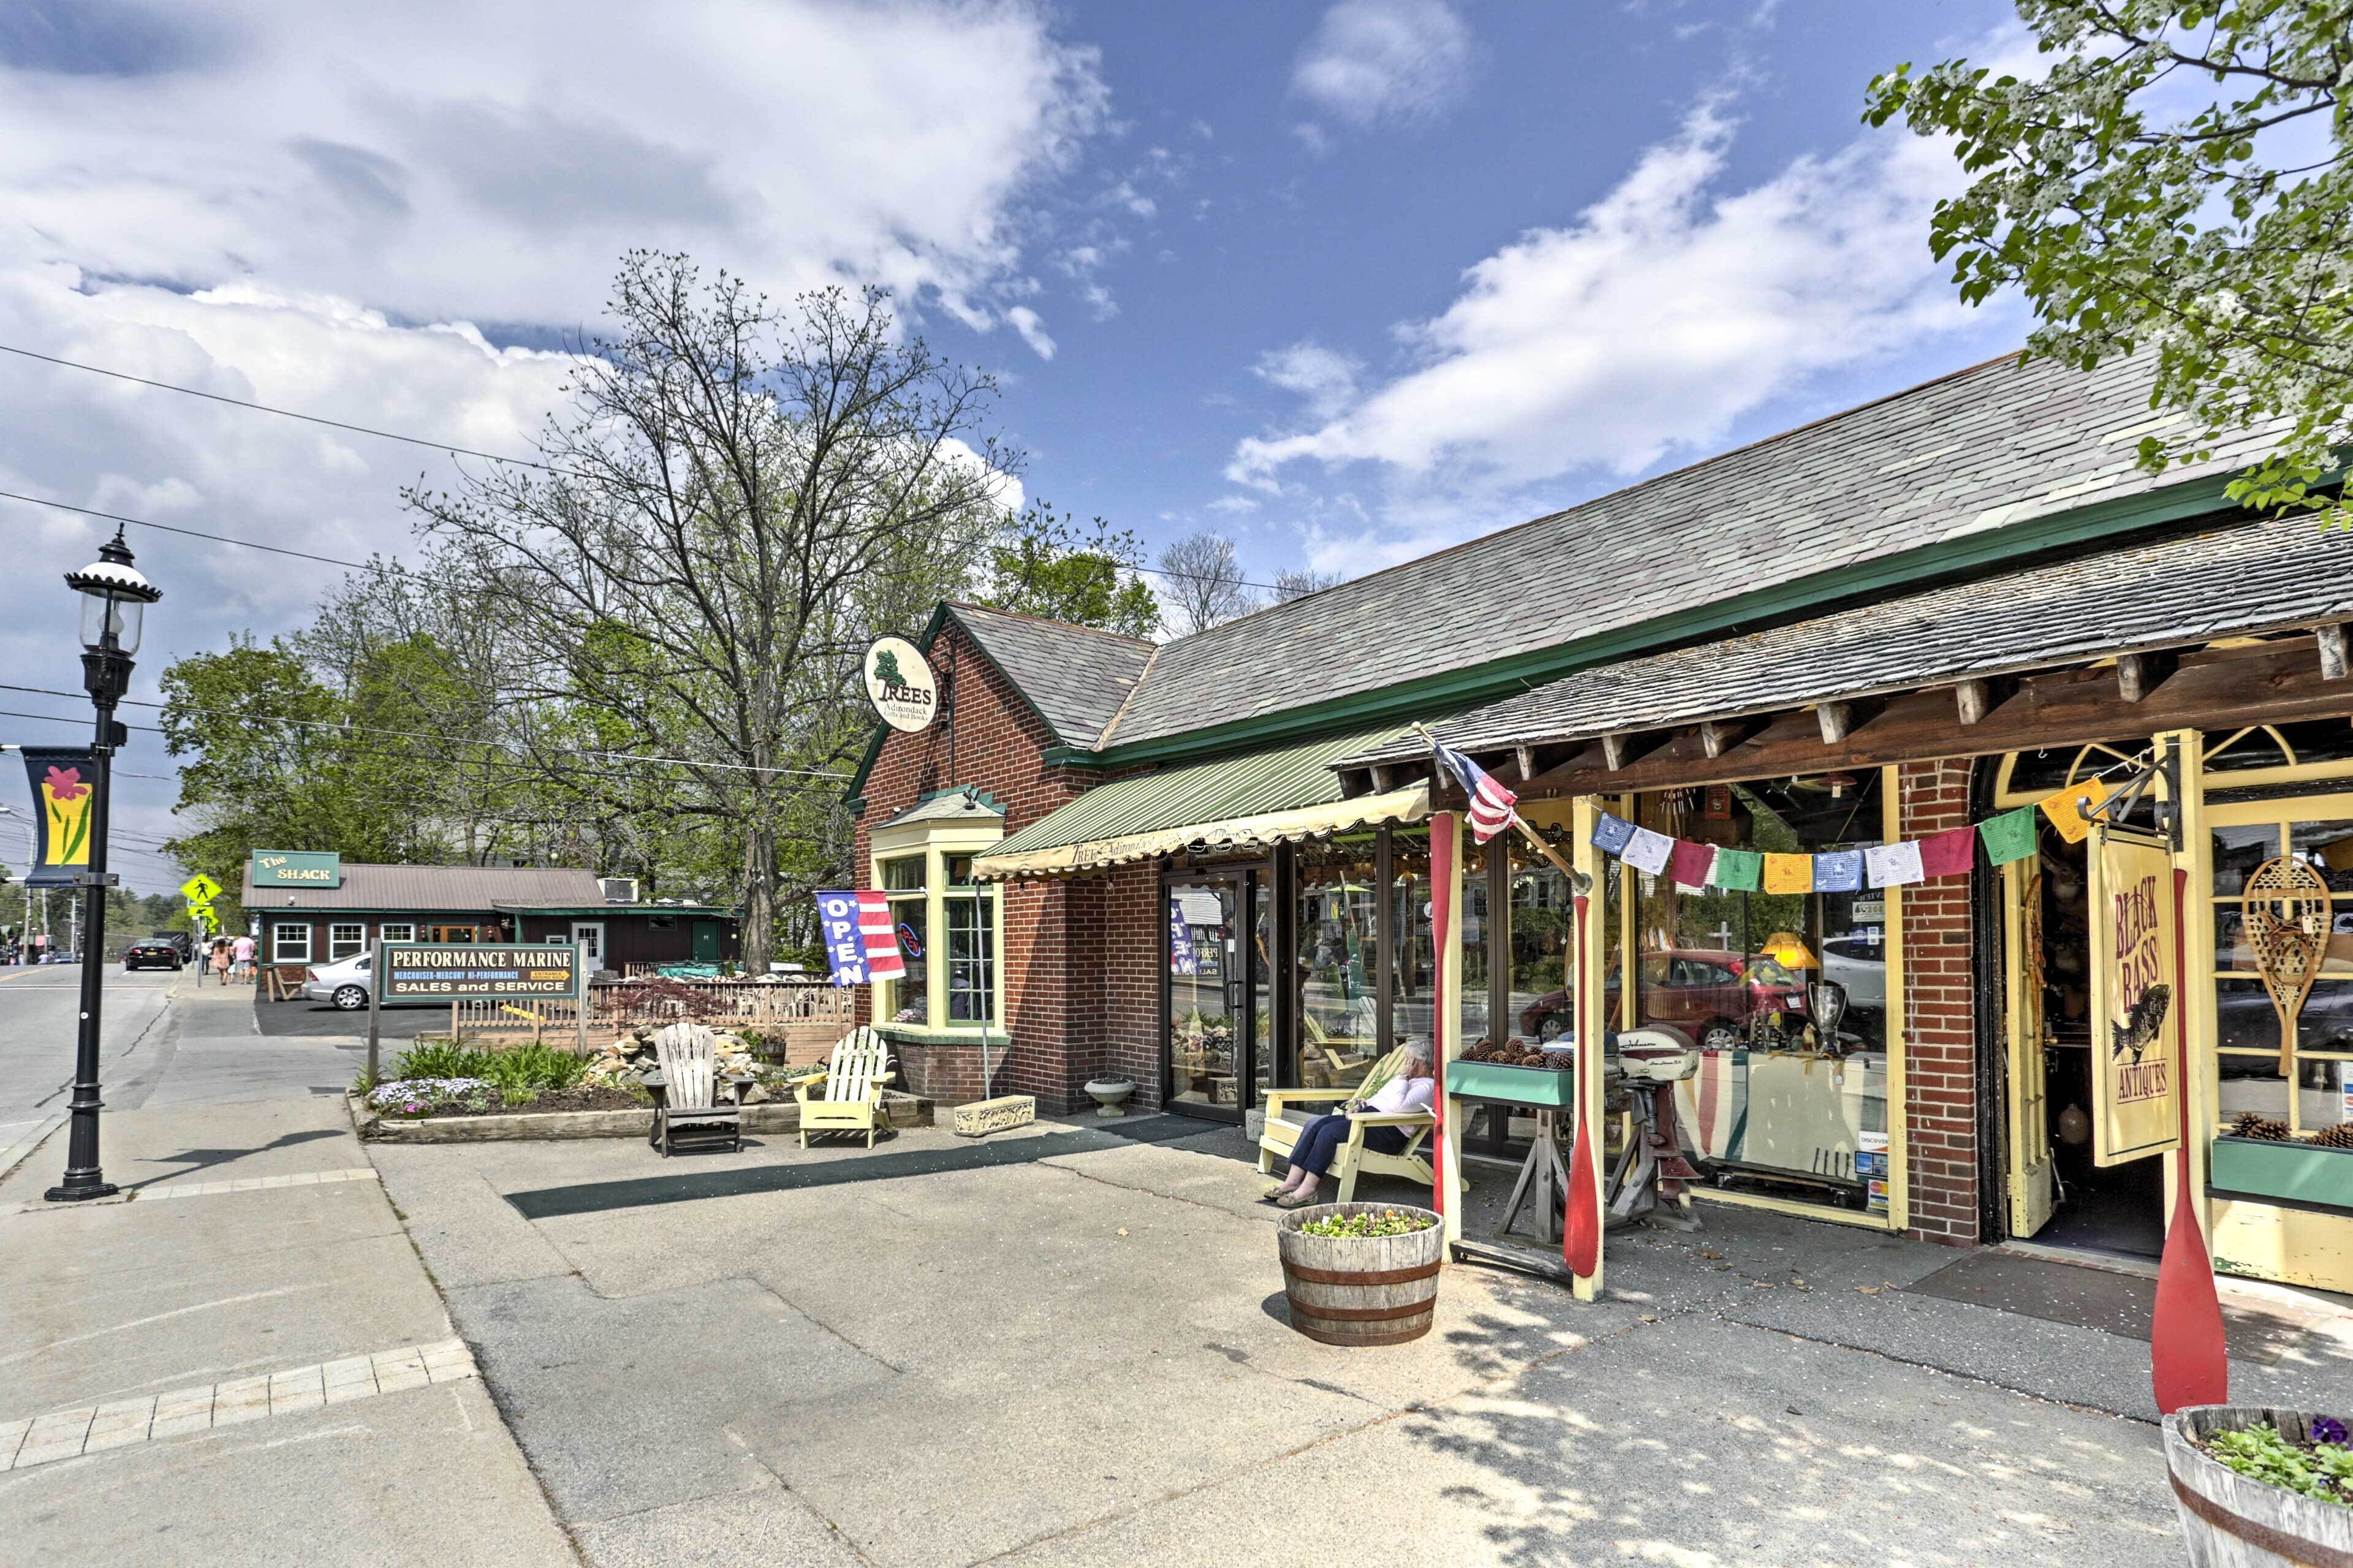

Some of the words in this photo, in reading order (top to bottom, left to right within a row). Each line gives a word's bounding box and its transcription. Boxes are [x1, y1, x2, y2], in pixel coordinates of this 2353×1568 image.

[878, 680, 931, 705] TREES
[884, 703, 927, 714] Adirondack
[259, 856, 287, 869] The
[278, 868, 330, 881] SHACK
[2115, 876, 2158, 960] BLACK
[827, 899, 864, 986] OPEN
[900, 926, 919, 953] OPEN
[392, 951, 506, 968] PERFORMANCE
[513, 952, 570, 968] MARINE
[393, 971, 466, 980] MERCRUISER-MERCURY
[468, 971, 519, 980] HI-PERFORMANCE
[2122, 935, 2158, 1013] BASS
[396, 982, 452, 992] SALES
[458, 982, 488, 991] and
[494, 982, 565, 991] SERVICE
[1619, 1039, 1656, 1048] Johnson
[2118, 1063, 2167, 1099] ANTIQUES
